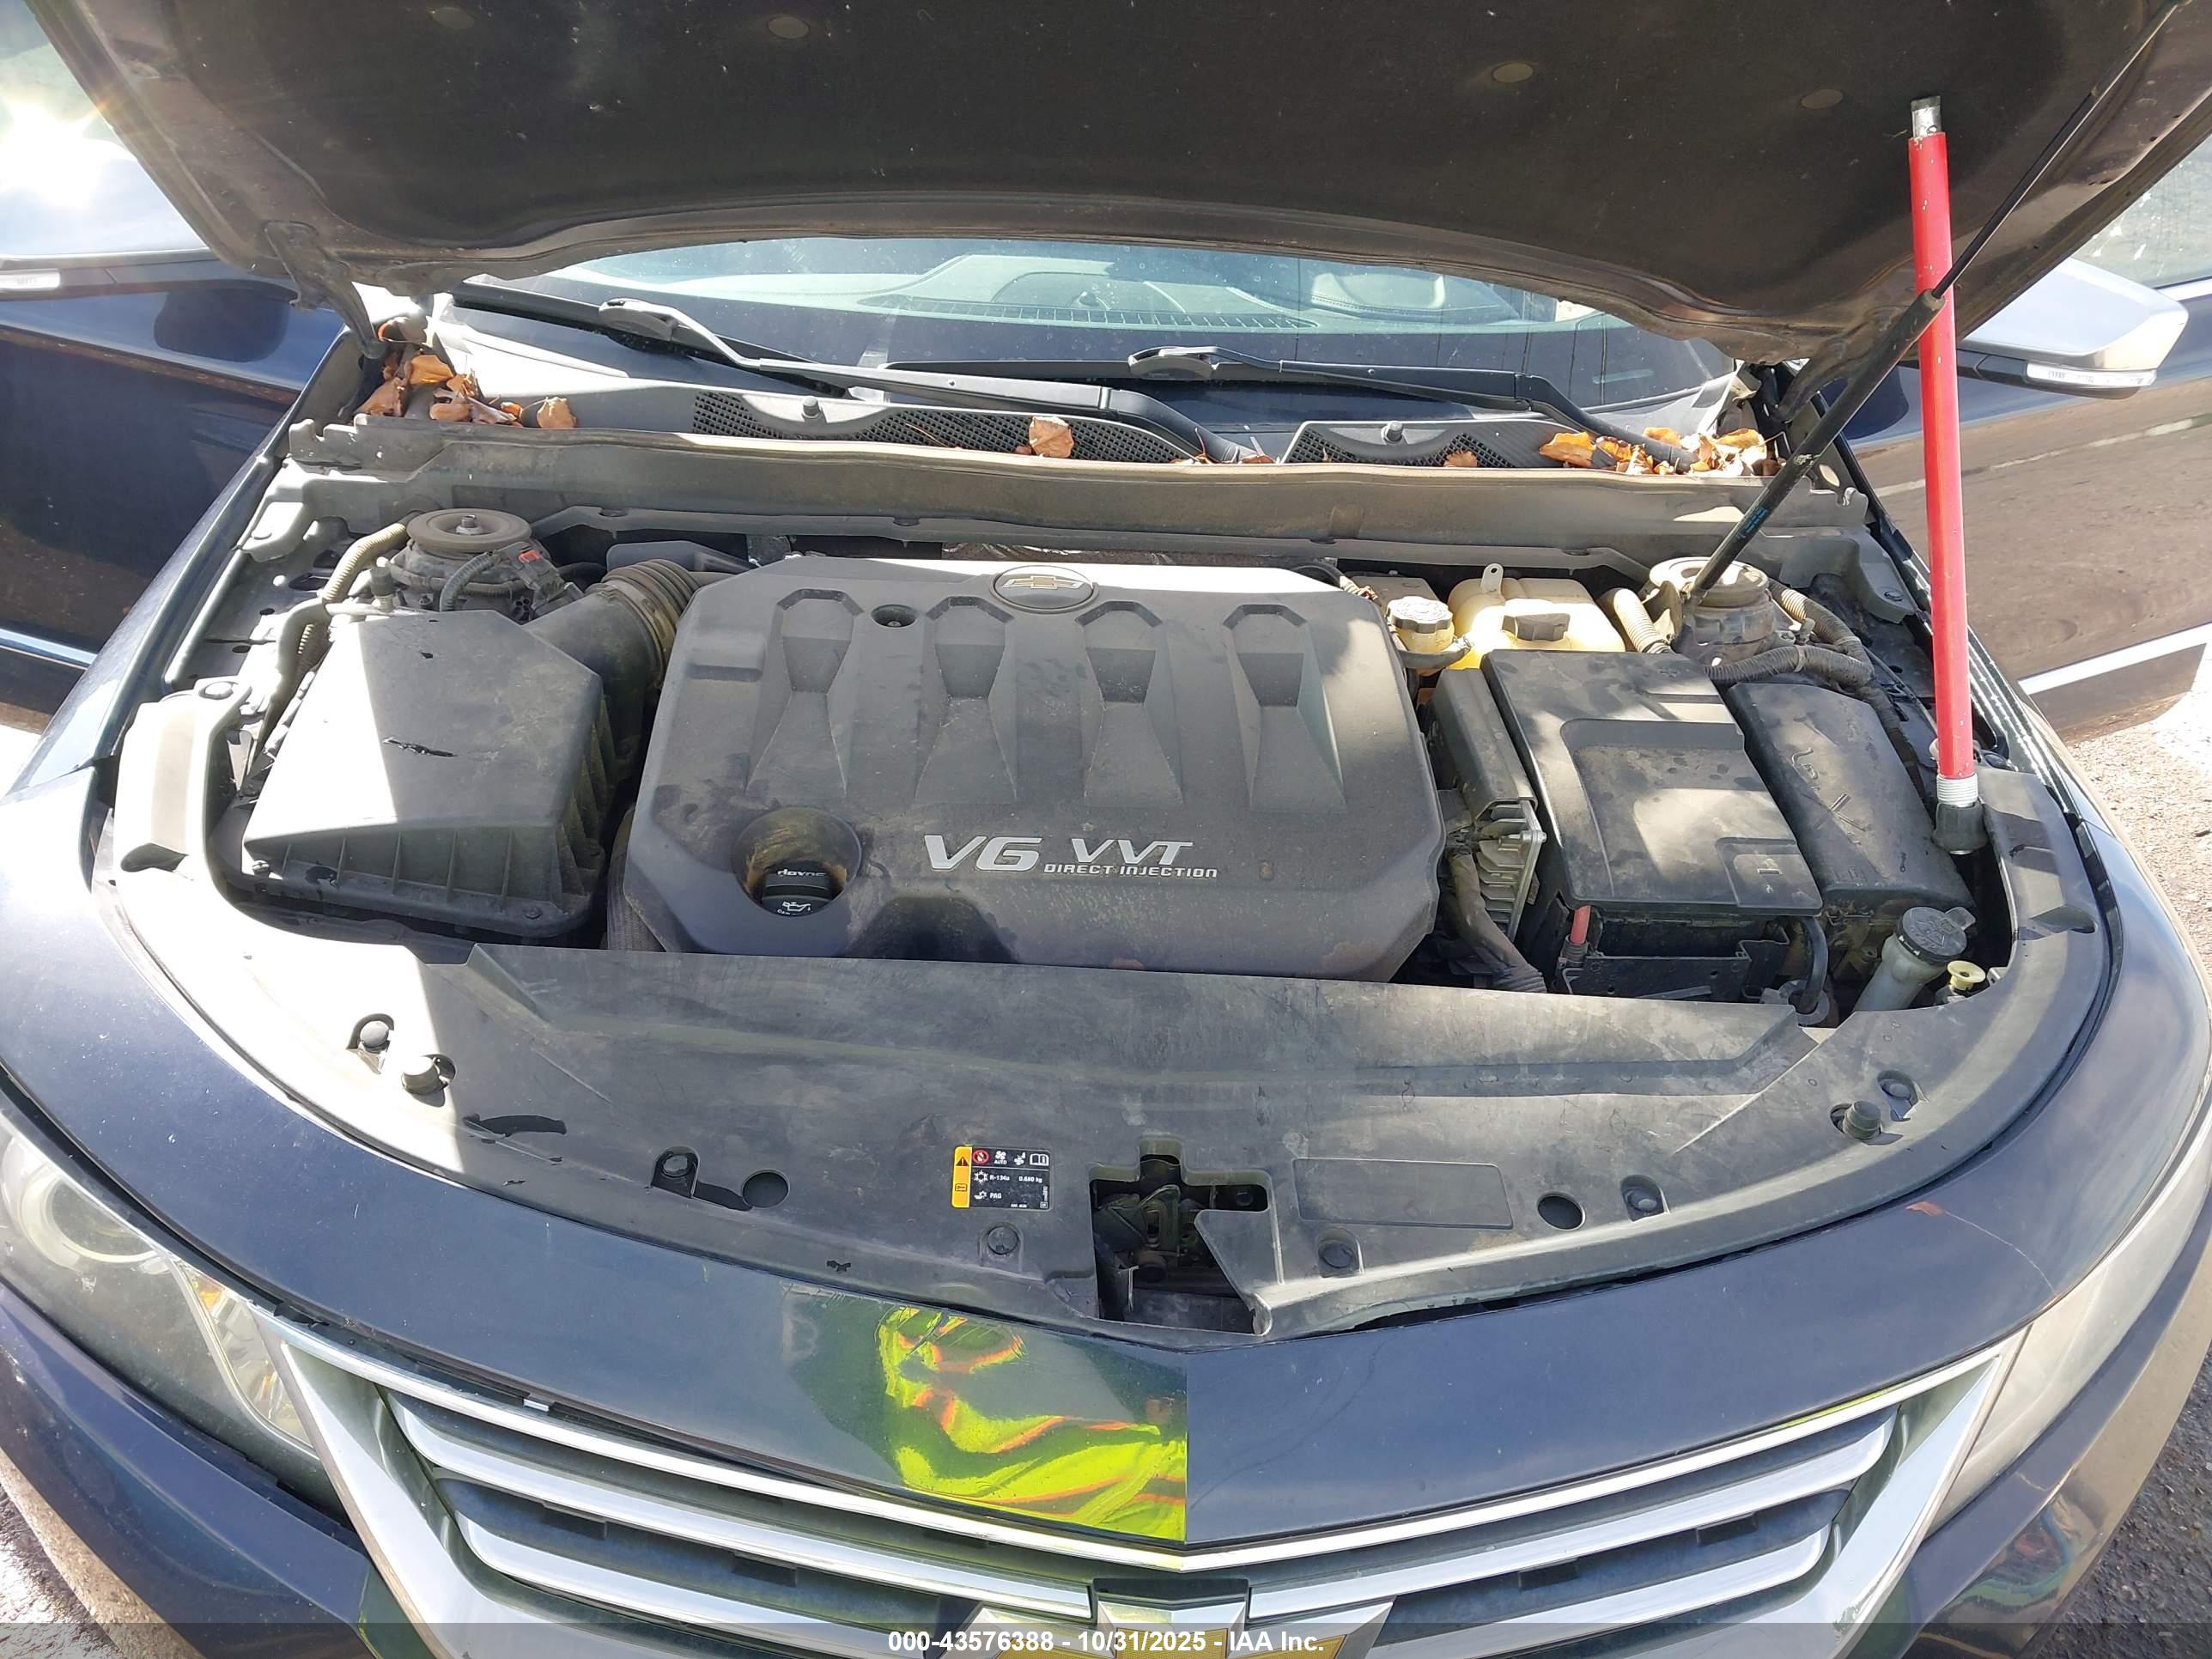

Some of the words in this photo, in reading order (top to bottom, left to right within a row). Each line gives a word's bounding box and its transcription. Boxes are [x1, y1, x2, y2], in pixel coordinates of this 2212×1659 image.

[924, 835, 1043, 872] V6
[1071, 838, 1194, 866] VVT
[1043, 864, 1114, 876] DIRECT
[1119, 866, 1218, 878] INJECTION
